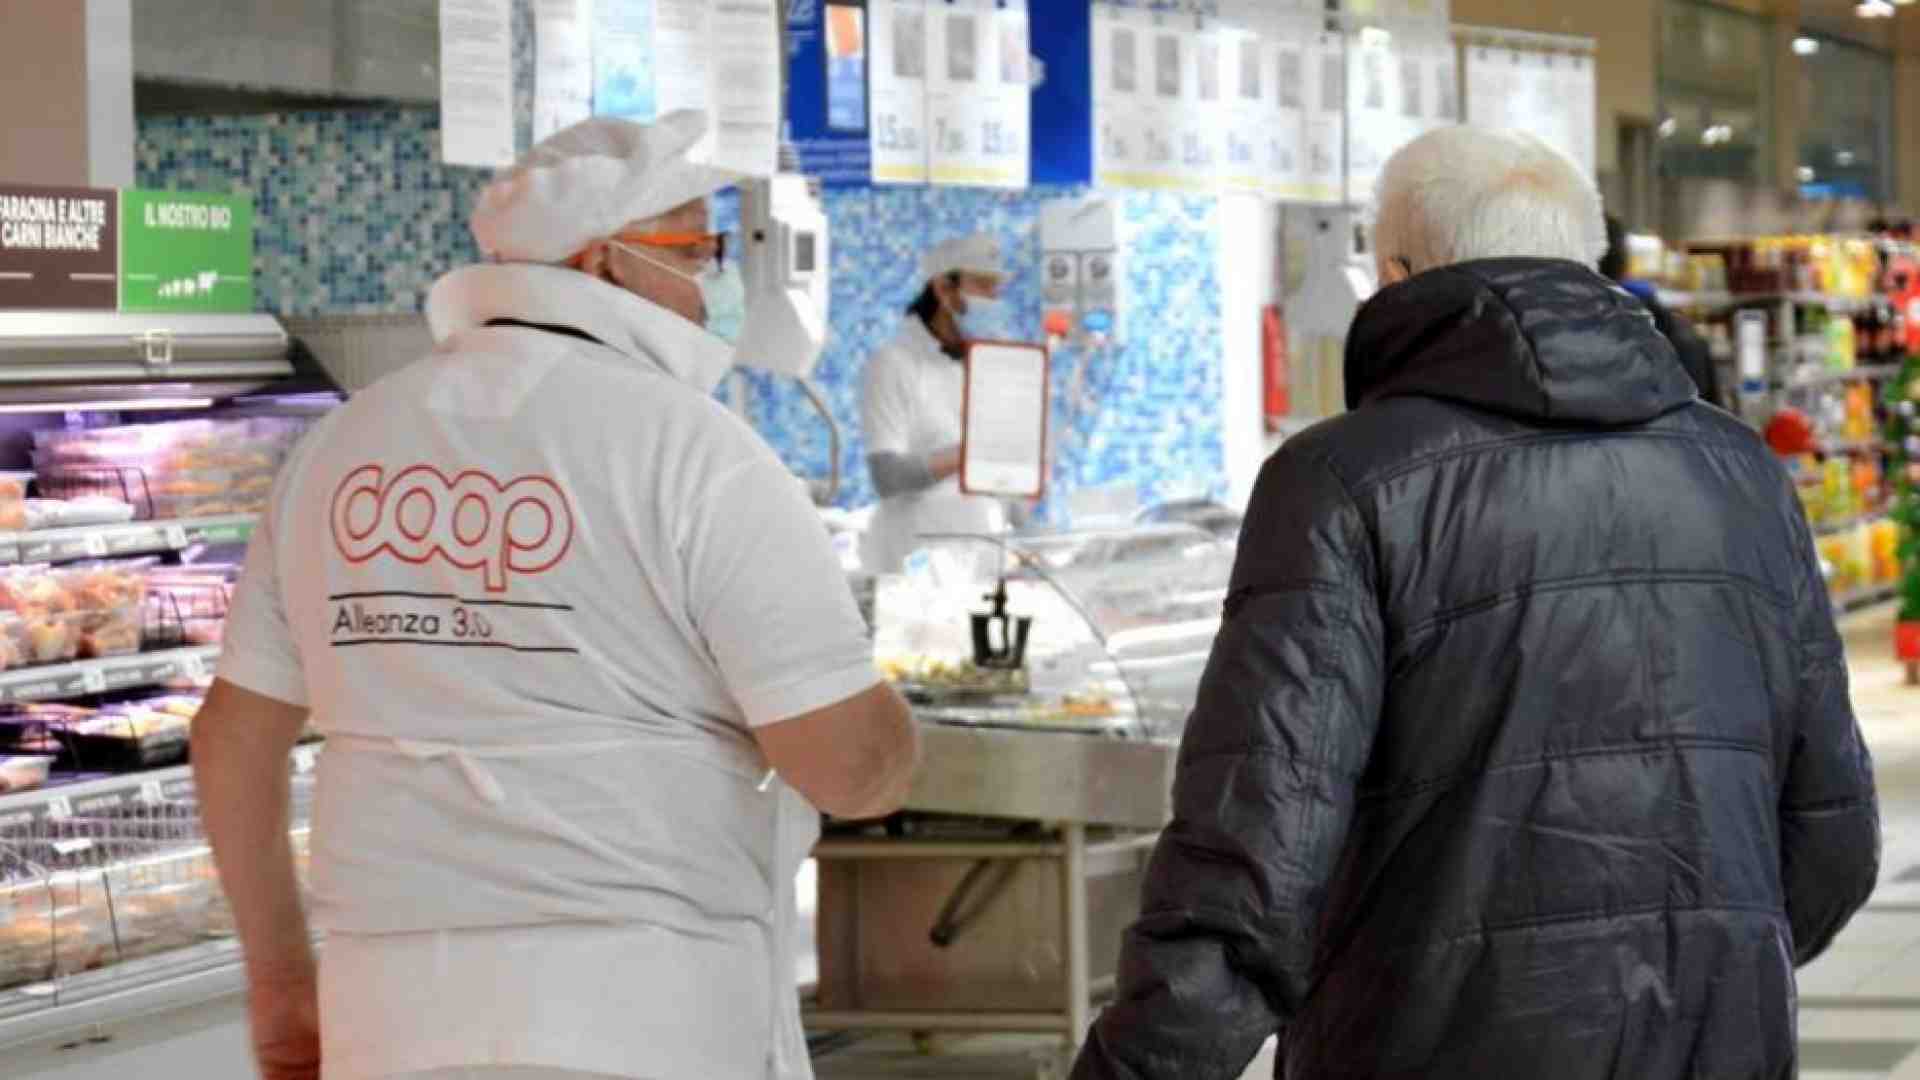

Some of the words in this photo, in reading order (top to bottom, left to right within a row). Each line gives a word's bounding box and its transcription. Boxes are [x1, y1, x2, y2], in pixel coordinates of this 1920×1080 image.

[58, 197, 67, 223] E
[69, 199, 106, 225] ALTRE
[144, 202, 156, 227] IL
[157, 202, 207, 228] NOSTRO
[2, 222, 41, 248] CARNI
[45, 223, 99, 250] BIANCHE
[330, 464, 574, 592] coop
